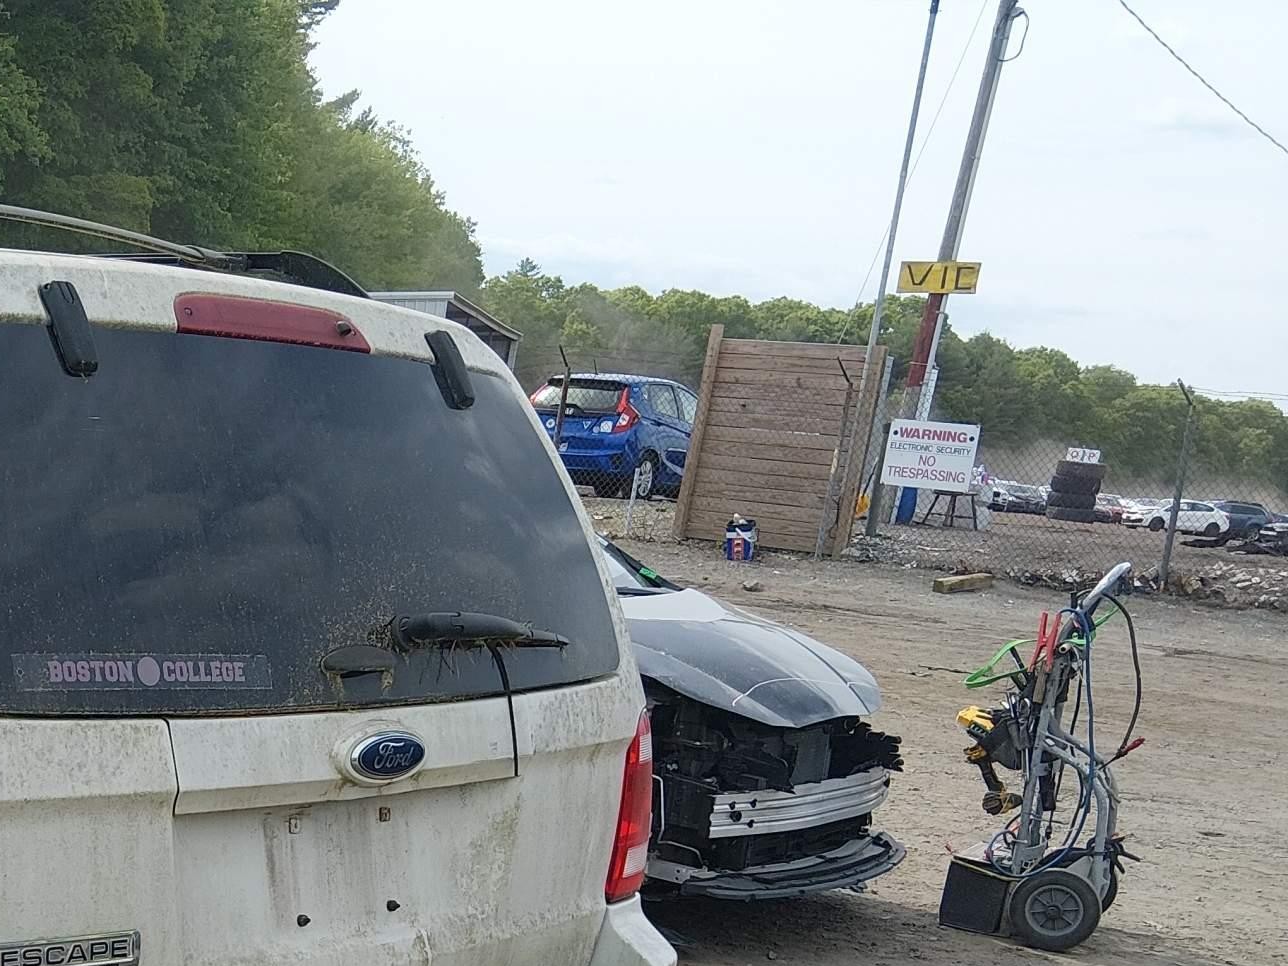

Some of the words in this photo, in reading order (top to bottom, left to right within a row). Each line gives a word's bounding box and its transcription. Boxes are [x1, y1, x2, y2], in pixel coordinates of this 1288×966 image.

[907, 264, 975, 290] VIC
[899, 427, 968, 443] WARNING
[890, 441, 933, 453] ELECTRONIC
[935, 446, 972, 456] SECURITY
[918, 455, 936, 467] NO
[888, 466, 966, 484] TRESPASSING
[48, 660, 134, 683] BOSTON
[163, 661, 246, 683] COLLEGE
[374, 741, 414, 769] Ford
